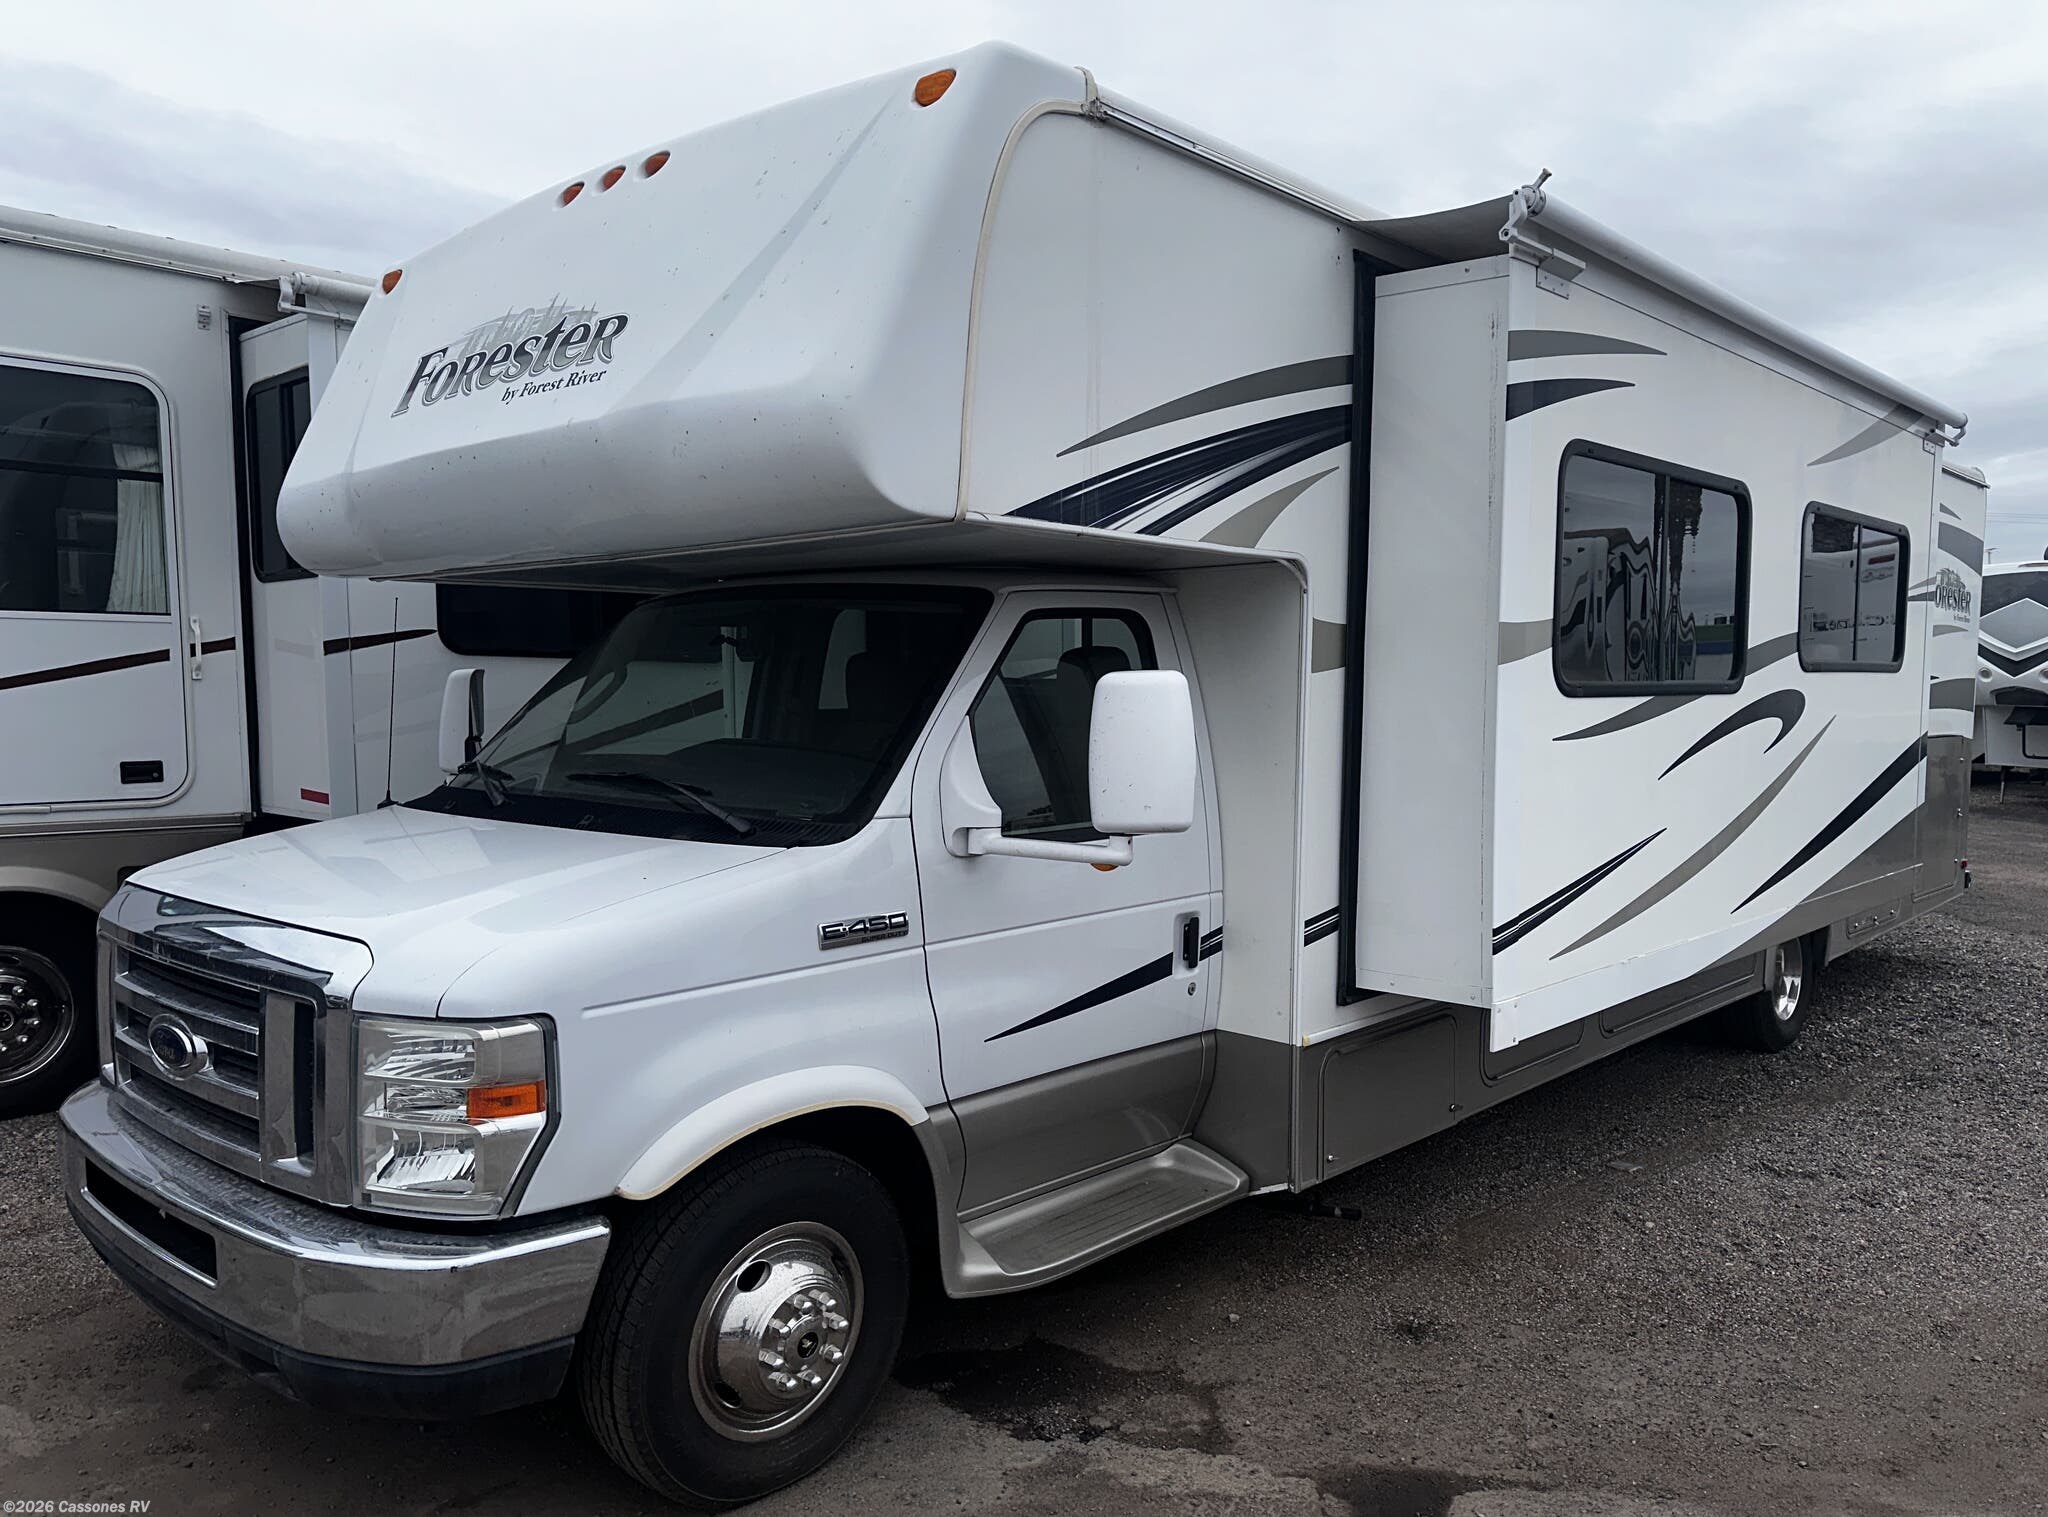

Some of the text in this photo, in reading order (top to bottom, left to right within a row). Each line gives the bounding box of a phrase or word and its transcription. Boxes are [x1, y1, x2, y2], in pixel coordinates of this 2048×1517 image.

[501, 370, 607, 405] by Forest River
[821, 913, 907, 940] E-450
